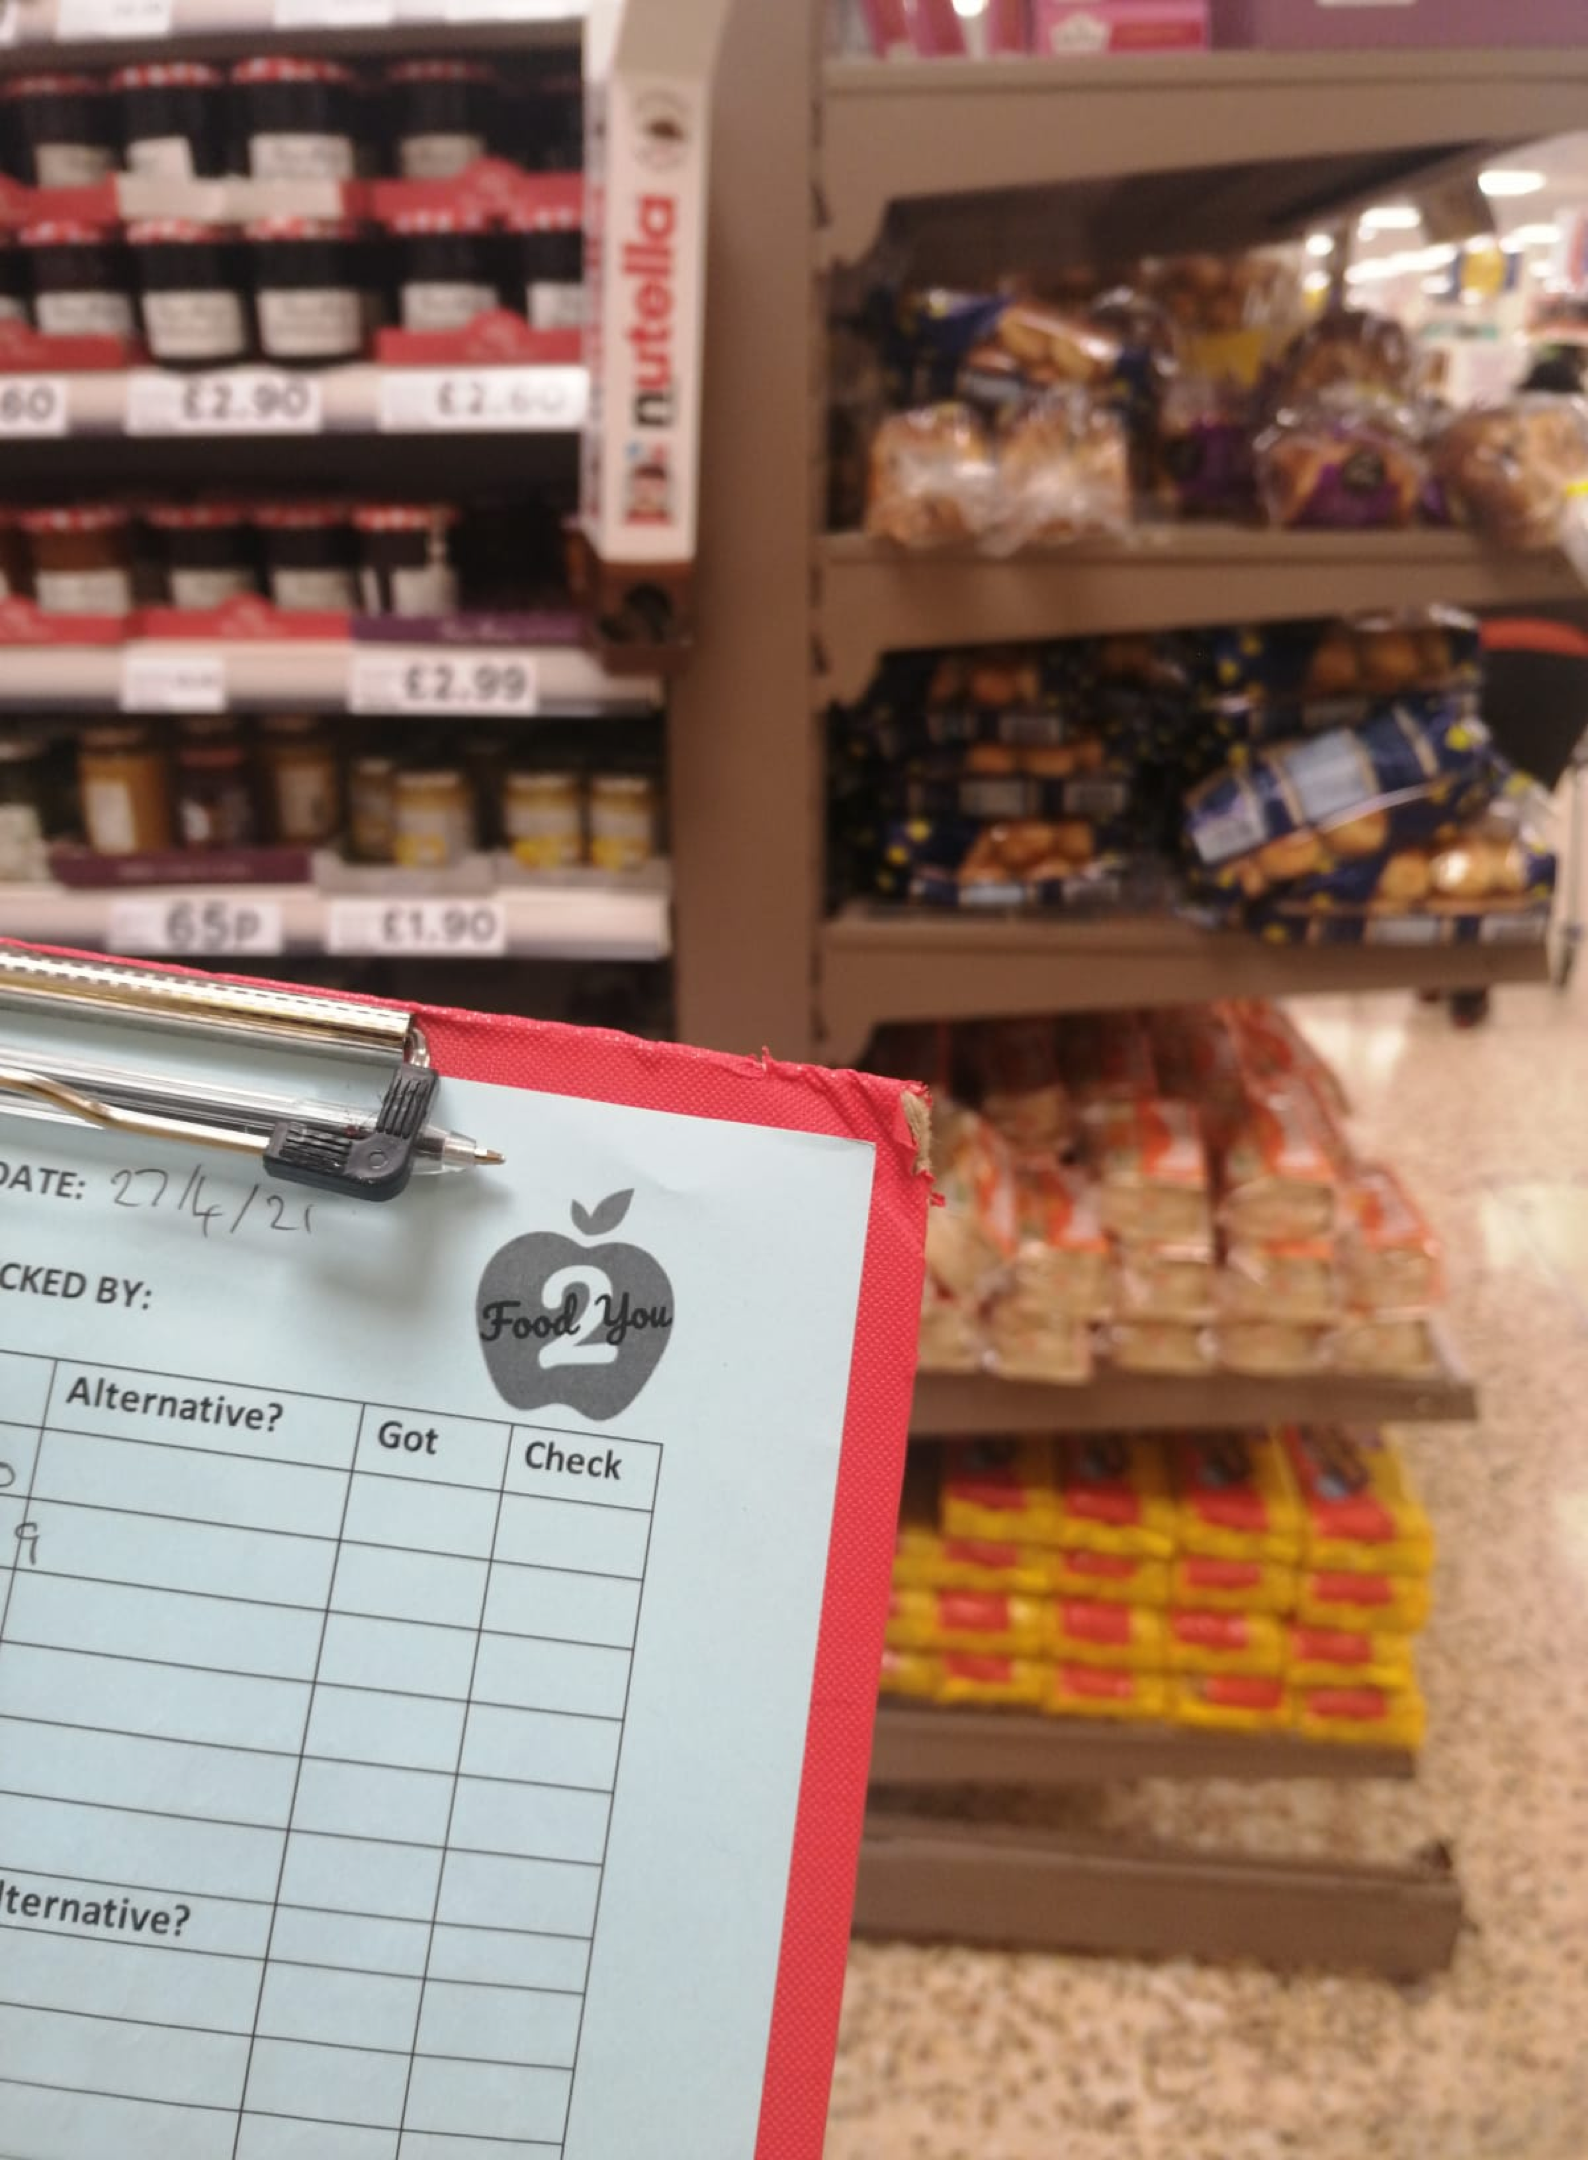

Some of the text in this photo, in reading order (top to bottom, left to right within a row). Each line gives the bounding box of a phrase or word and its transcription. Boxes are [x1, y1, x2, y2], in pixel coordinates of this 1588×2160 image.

[622, 194, 678, 428] nutella
[183, 381, 310, 421] £2.90
[404, 664, 528, 702] £2.99
[382, 907, 498, 944] £1.90
[95, 1275, 153, 1311] BY:
[480, 1264, 673, 1370] Food 2 You
[66, 1376, 284, 1433] Alternative?
[378, 1420, 439, 1455] Got
[524, 1441, 623, 1480] Check
